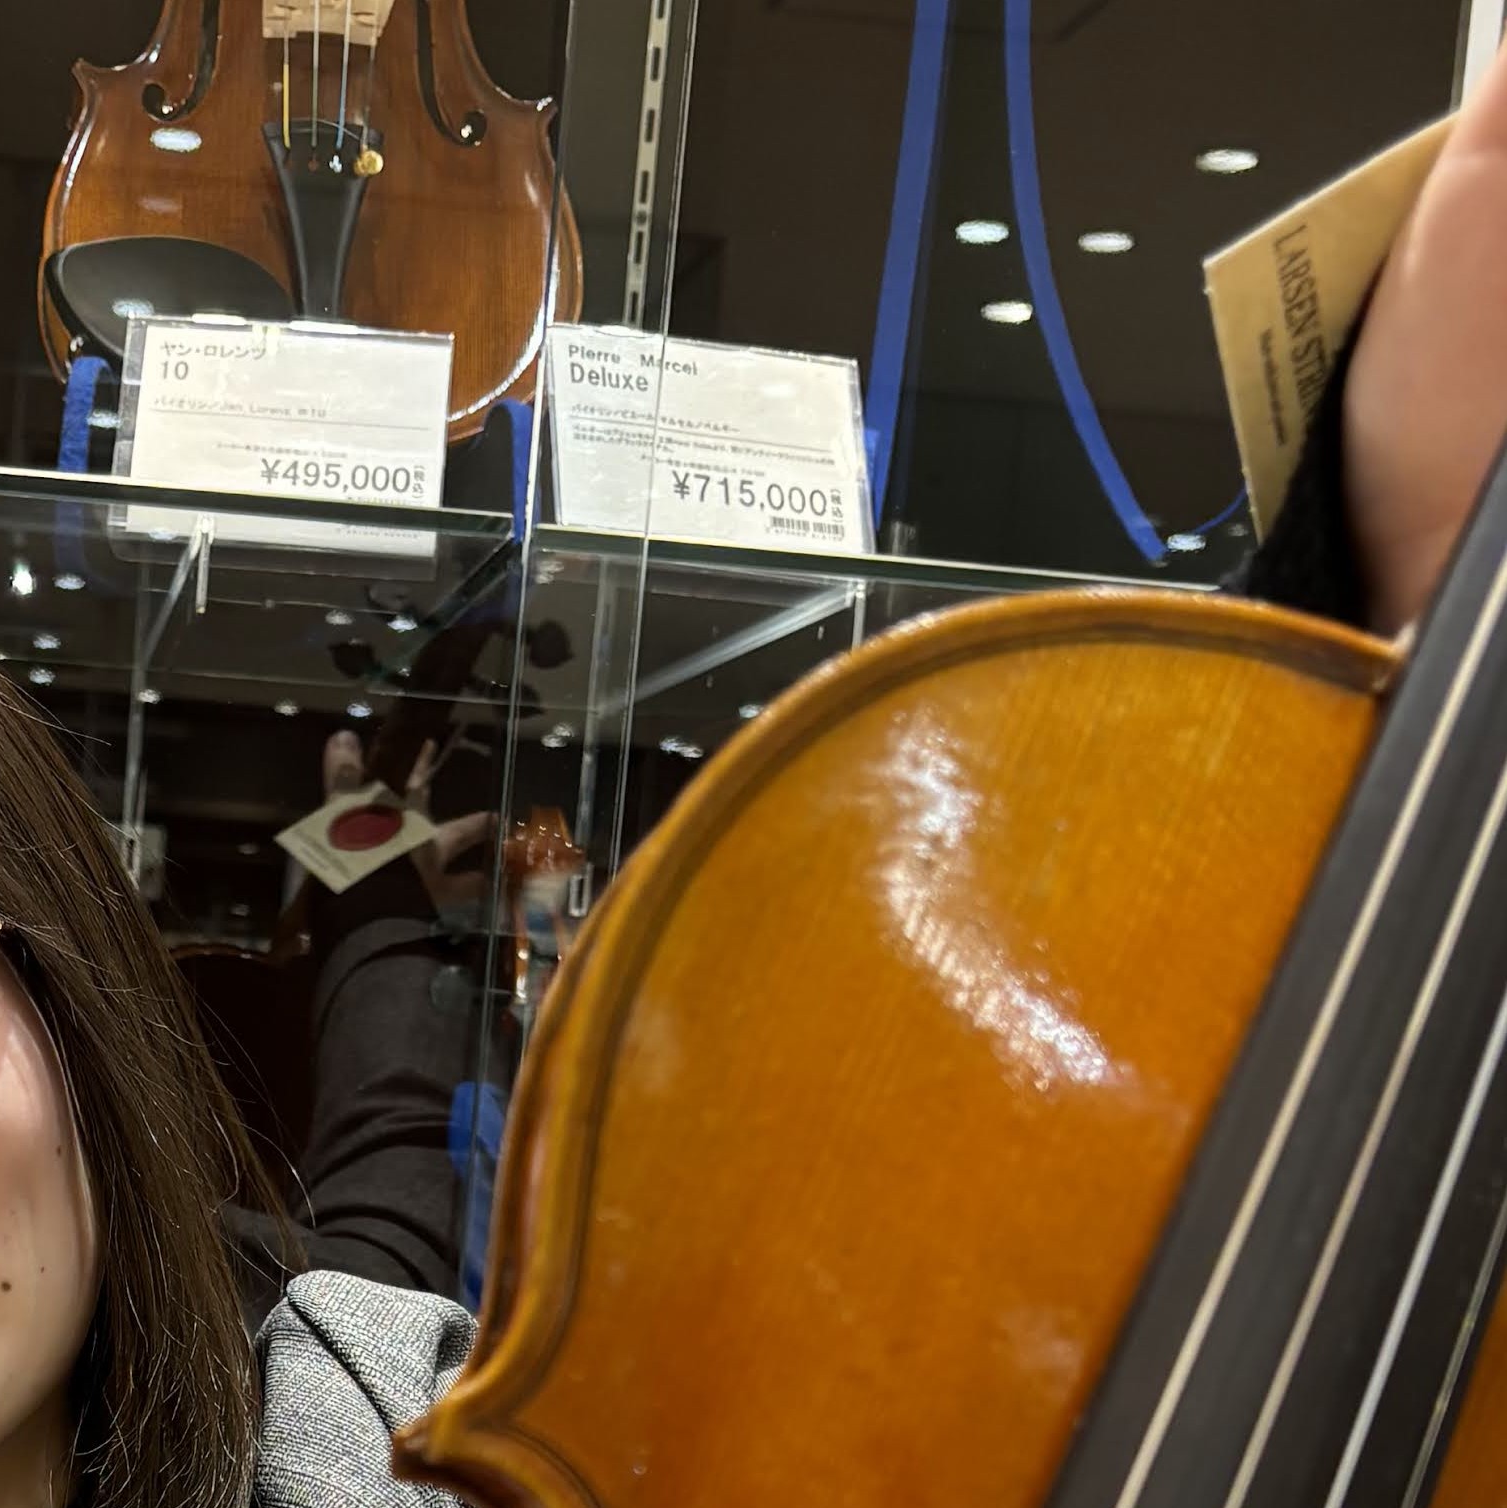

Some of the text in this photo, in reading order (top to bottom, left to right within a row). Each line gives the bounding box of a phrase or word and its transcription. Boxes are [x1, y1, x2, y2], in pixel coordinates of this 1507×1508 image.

[1273, 224, 1321, 338] LARSEN
[161, 360, 189, 381] 10
[568, 344, 621, 364] Pierre
[569, 361, 649, 393] Deluxe
[261, 458, 411, 494] ¥495,000
[673, 470, 828, 517] ¥715,000
